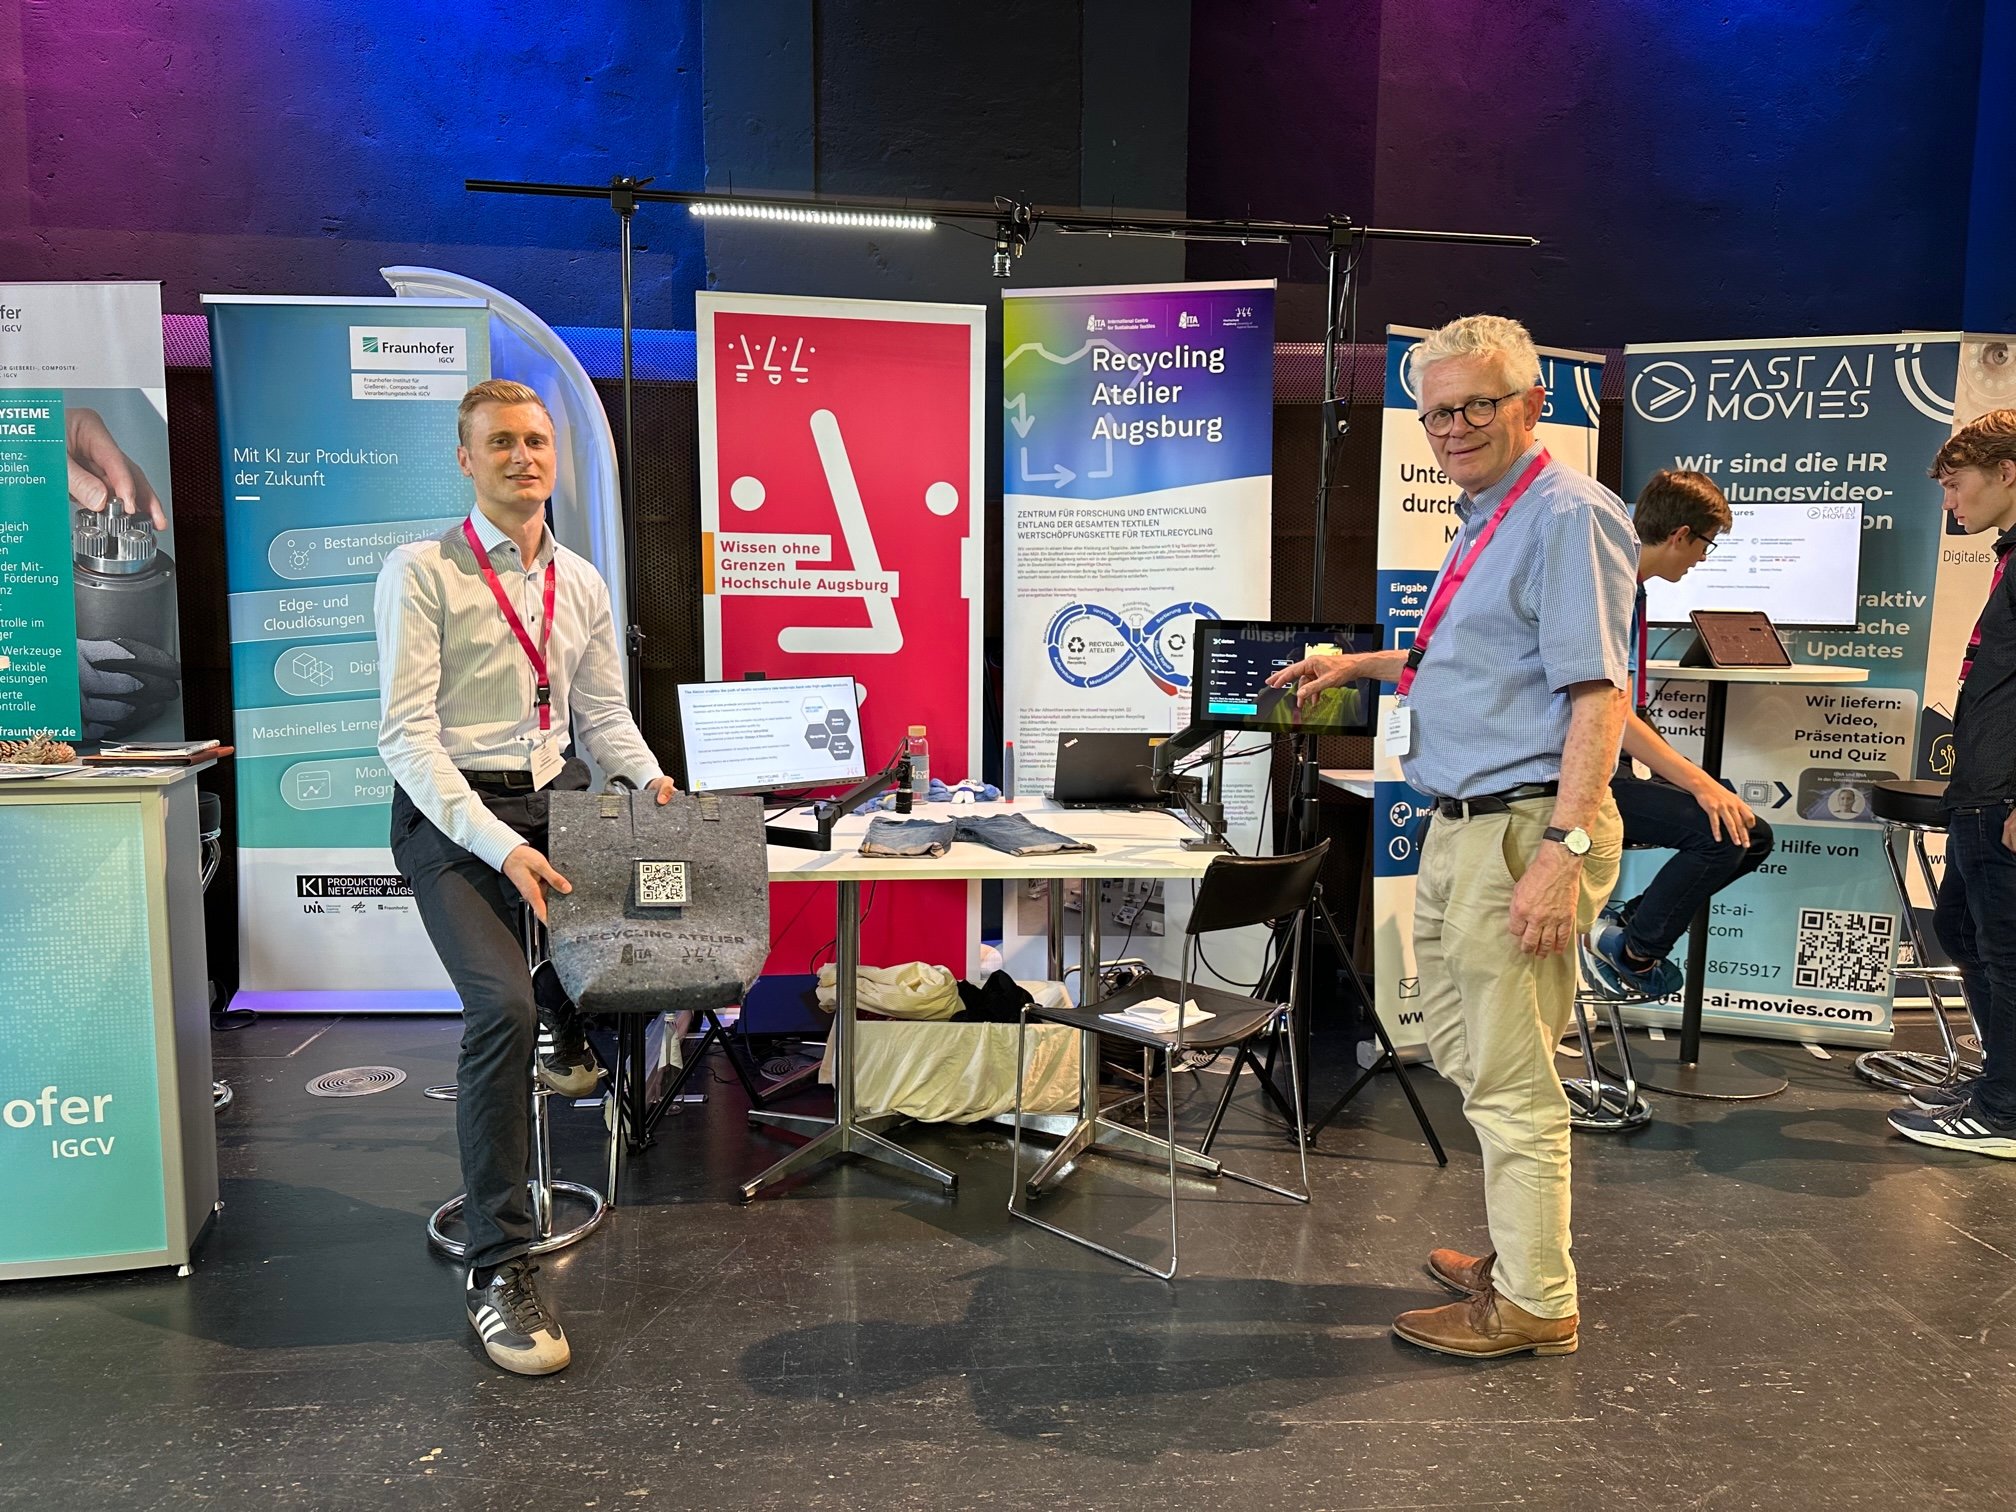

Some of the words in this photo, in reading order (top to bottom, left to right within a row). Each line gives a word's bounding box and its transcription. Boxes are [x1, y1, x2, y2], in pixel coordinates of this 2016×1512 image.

[1, 324, 22, 333] IGCV
[381, 341, 455, 355] Fraunhofer
[438, 356, 455, 364] IGCV
[1093, 345, 1225, 376] Recycling
[1709, 355, 1816, 391] FAST
[1825, 353, 1874, 388] AI
[1092, 380, 1182, 406] Atelier
[1706, 390, 1870, 421] MOVIES
[1091, 414, 1223, 445] Augsburg
[233, 447, 260, 464] Mit
[265, 447, 281, 463] KI
[286, 450, 311, 464] zur
[316, 449, 399, 465] Produktion
[1674, 453, 1723, 474] Wir
[1730, 452, 1787, 473] sind
[1794, 451, 1839, 473] die
[1847, 453, 1888, 472] HR
[234, 470, 260, 486] der
[264, 470, 326, 487] Zukunft
[1017, 510, 1057, 518] ZENTRUM
[1058, 509, 1074, 518] FÜR
[1076, 509, 1126, 518] FORSCHUNG
[1127, 508, 1145, 517] UND
[1146, 506, 1207, 516] ENTWICKLUNG
[1017, 521, 1055, 529] ENTLANG
[1057, 520, 1073, 528] DER
[1074, 520, 1120, 528] GESAMTEN
[1121, 519, 1160, 528] TEXTILEN
[1017, 530, 1120, 539] WERTSCHÖPFUNGSKETTE
[1122, 529, 1138, 538] FÜR
[1140, 528, 1213, 538] TEXTILRECYCLING
[720, 540, 777, 554] Wissen
[782, 542, 821, 555] ohne
[347, 551, 374, 566] und
[721, 558, 786, 572] Grenzen
[1943, 549, 1991, 566] Digitales
[0, 561, 18, 572] der
[21, 561, 44, 572] Mit-
[4, 573, 59, 586] Förderung
[721, 576, 812, 590] Hochschule
[816, 578, 889, 593] Augsburg
[1390, 582, 1428, 593] Eingabe
[279, 598, 319, 613] Edge-
[322, 594, 349, 609] und
[1401, 595, 1418, 605] des
[31, 617, 45, 628] im
[263, 613, 365, 631] Cloudlösungen
[1, 645, 62, 659] Werkzeuge
[1807, 641, 1904, 660] Updates
[8, 662, 47, 672] flexible
[1805, 695, 1836, 707] Wir
[1840, 696, 1901, 710] liefern:
[1668, 707, 1706, 720] oder
[1824, 713, 1878, 728] Video,
[0, 725, 77, 738] fraunhofer.de
[252, 721, 337, 740] Maschinelles
[341, 719, 380, 732] Lerne
[1794, 729, 1906, 746] Präsentation
[1809, 748, 1843, 760] und
[1847, 749, 1887, 762] Quiz
[1781, 839, 1822, 855] Hilfe
[1827, 844, 1859, 857] von
[302, 877, 323, 896] KI
[327, 877, 403, 887] PRODUKTIONS-
[327, 886, 383, 896] NETZWERK
[678, 933, 745, 944] ATELIER
[1708, 959, 1781, 978] 8675917
[52, 1136, 115, 1159] IGCV
